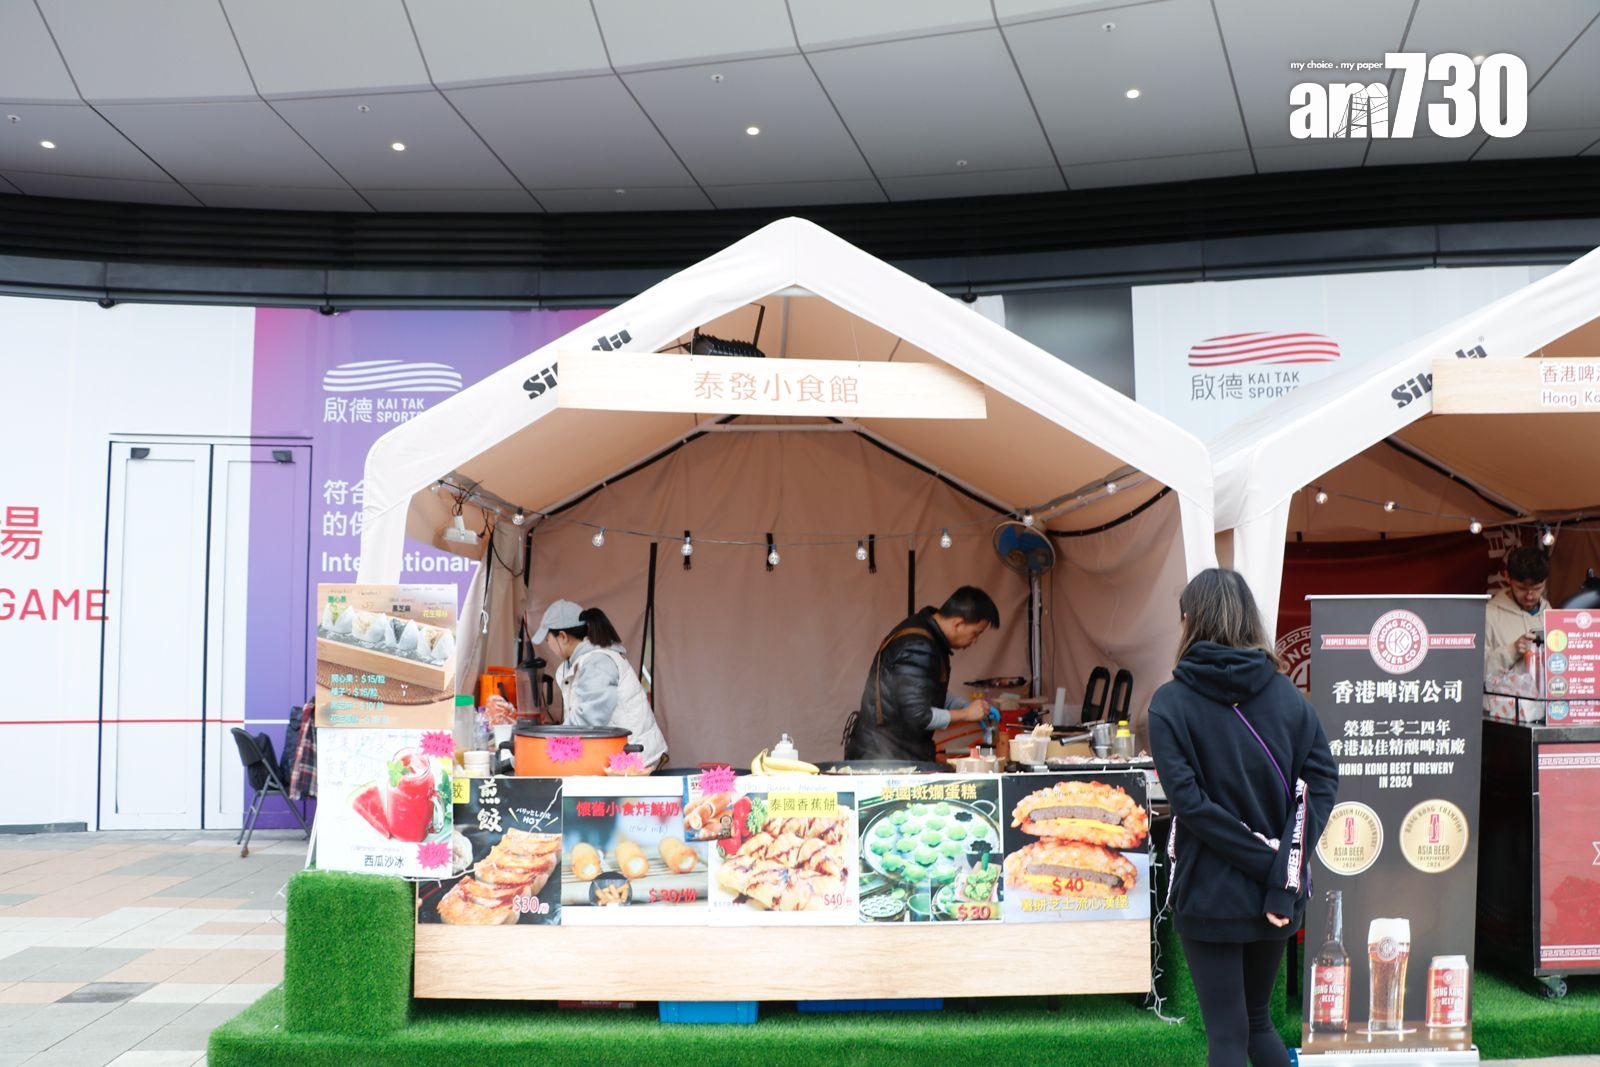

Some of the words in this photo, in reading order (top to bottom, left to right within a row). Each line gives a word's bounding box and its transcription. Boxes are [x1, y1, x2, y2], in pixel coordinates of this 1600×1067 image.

[1248, 373, 1270, 385] KAI
[1275, 371, 1300, 383] TAK
[694, 371, 859, 404] 泰發小食館
[1249, 385, 1298, 398] SPORT
[377, 398, 397, 410] KAI
[401, 398, 425, 410] TAK
[1543, 391, 1577, 406] Hong
[323, 397, 372, 423] 啟德
[0, 588, 110, 621] GAME
[1379, 620, 1399, 642] HONG
[1400, 620, 1420, 642] KONG
[1382, 651, 1402, 664] BEER
[1332, 679, 1463, 704] 香港啤酒公司
[1343, 719, 1451, 737] 榮獲二零二四年
[1328, 738, 1466, 756] 香港最佳精釀啤酒廠
[1338, 763, 1362, 776] HONG
[1364, 763, 1388, 775] KONG
[1390, 762, 1412, 774] BEST
[1413, 762, 1454, 775] BREWERY
[1379, 777, 1388, 788] IN
[1390, 776, 1413, 788] 2024
[770, 797, 836, 812] 泰國香蕉餅
